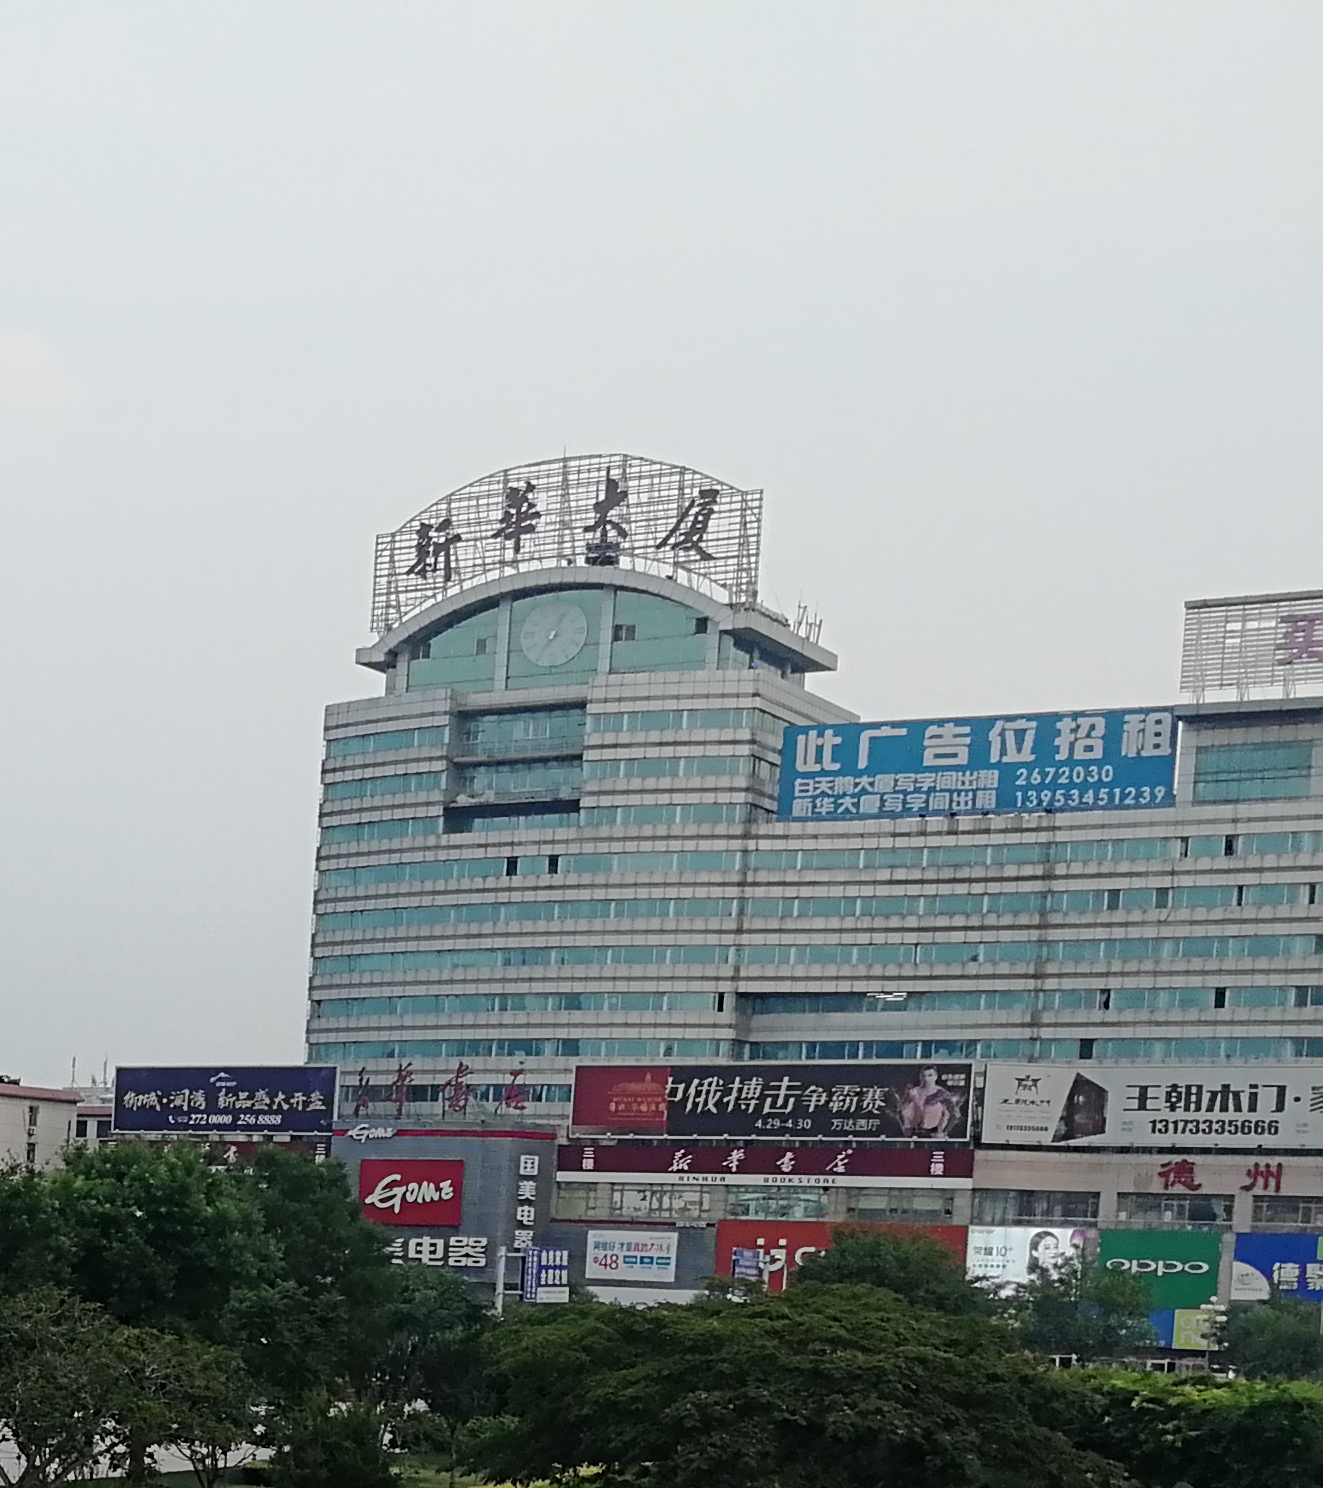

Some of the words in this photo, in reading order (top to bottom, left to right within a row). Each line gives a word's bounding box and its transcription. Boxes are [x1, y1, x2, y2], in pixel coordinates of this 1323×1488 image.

[795, 712, 1172, 772] 此广告位招租
[794, 769, 999, 797] 白天鹅大厦写字间出租
[1015, 765, 1114, 785] 2672030
[792, 790, 997, 817] 新华大厦写字间出租
[1015, 786, 1166, 808] 13953451239
[217, 1088, 327, 1111] 新品盛大开盘
[755, 1119, 811, 1129] 4.29-4.30
[831, 1119, 881, 1131] 万达西厅
[1149, 1119, 1280, 1136] 13173335666
[1158, 1159, 1283, 1193] 德州
[513, 1155, 539, 1248] 国美电器
[598, 1253, 619, 1270] 48
